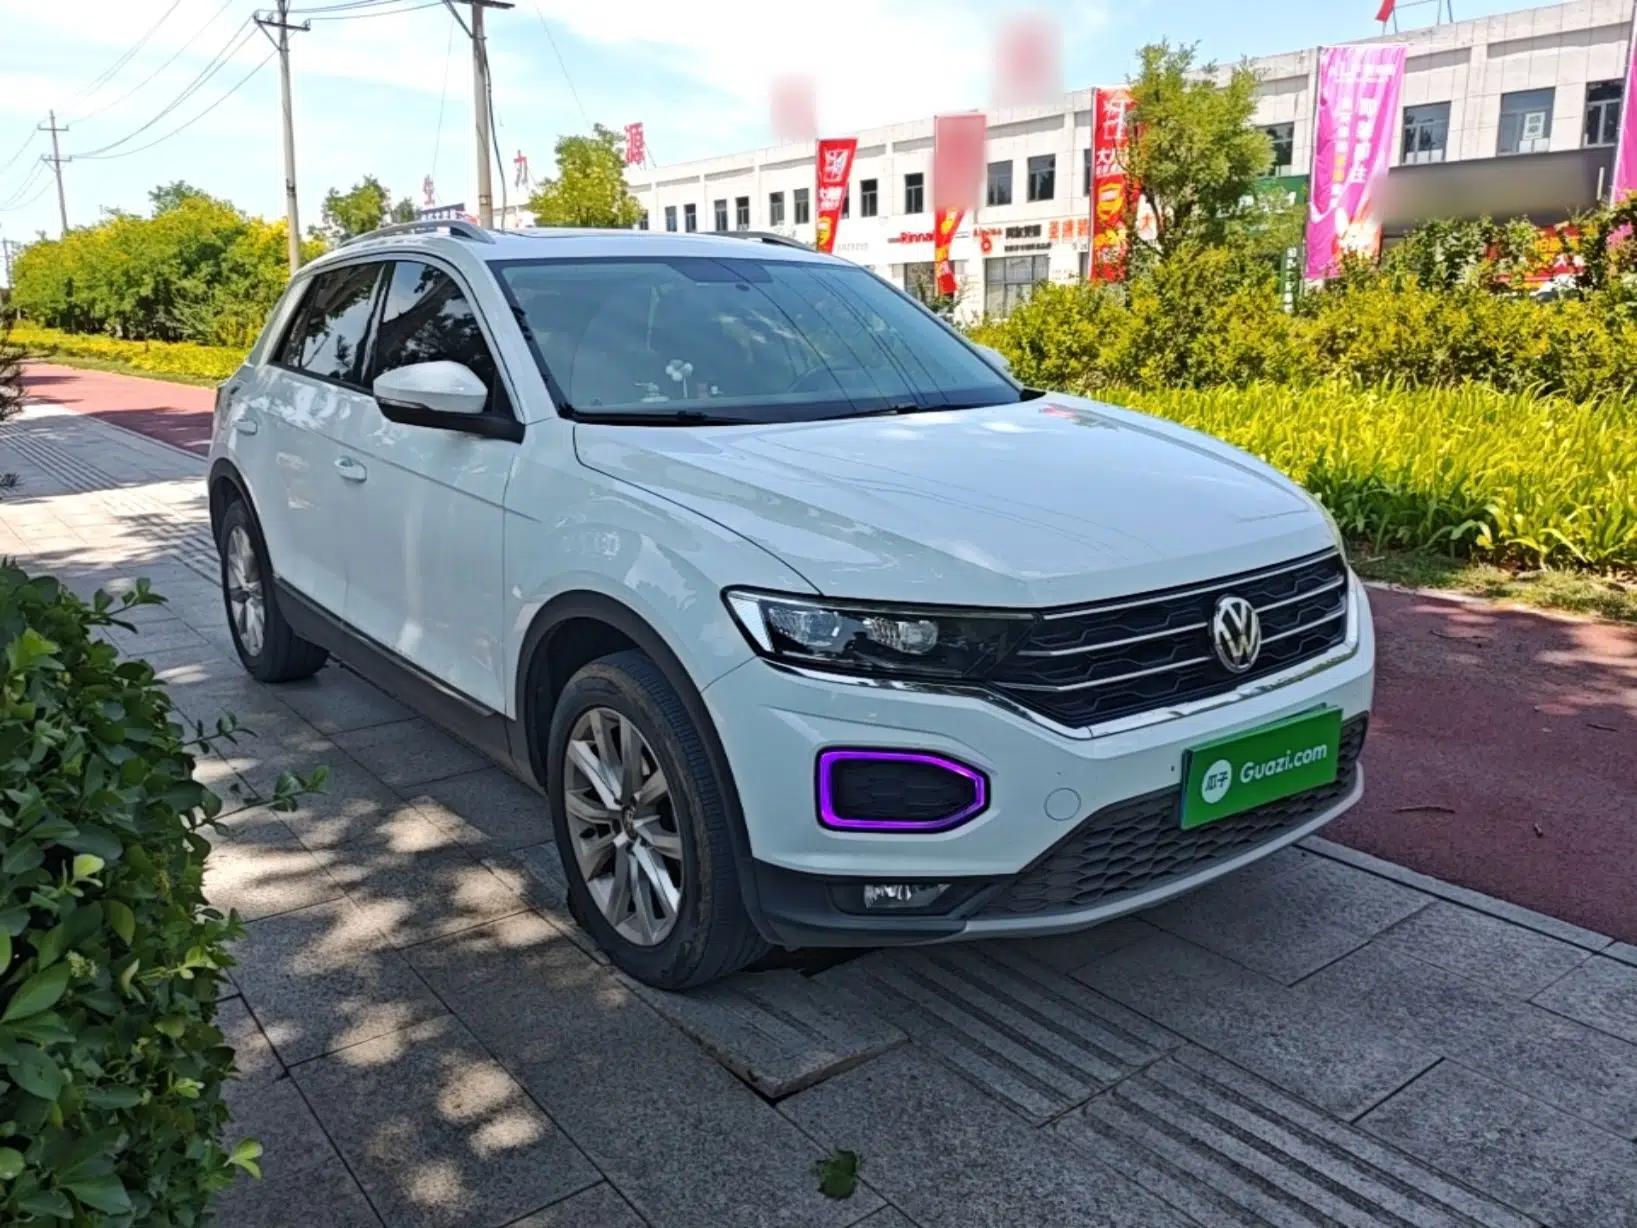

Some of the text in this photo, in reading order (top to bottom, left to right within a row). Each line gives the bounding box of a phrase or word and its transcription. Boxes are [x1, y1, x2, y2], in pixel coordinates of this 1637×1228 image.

[900, 231, 935, 244] Rinna
[1240, 744, 1327, 783] Guazi.com
[1205, 770, 1228, 791] 瓜子
